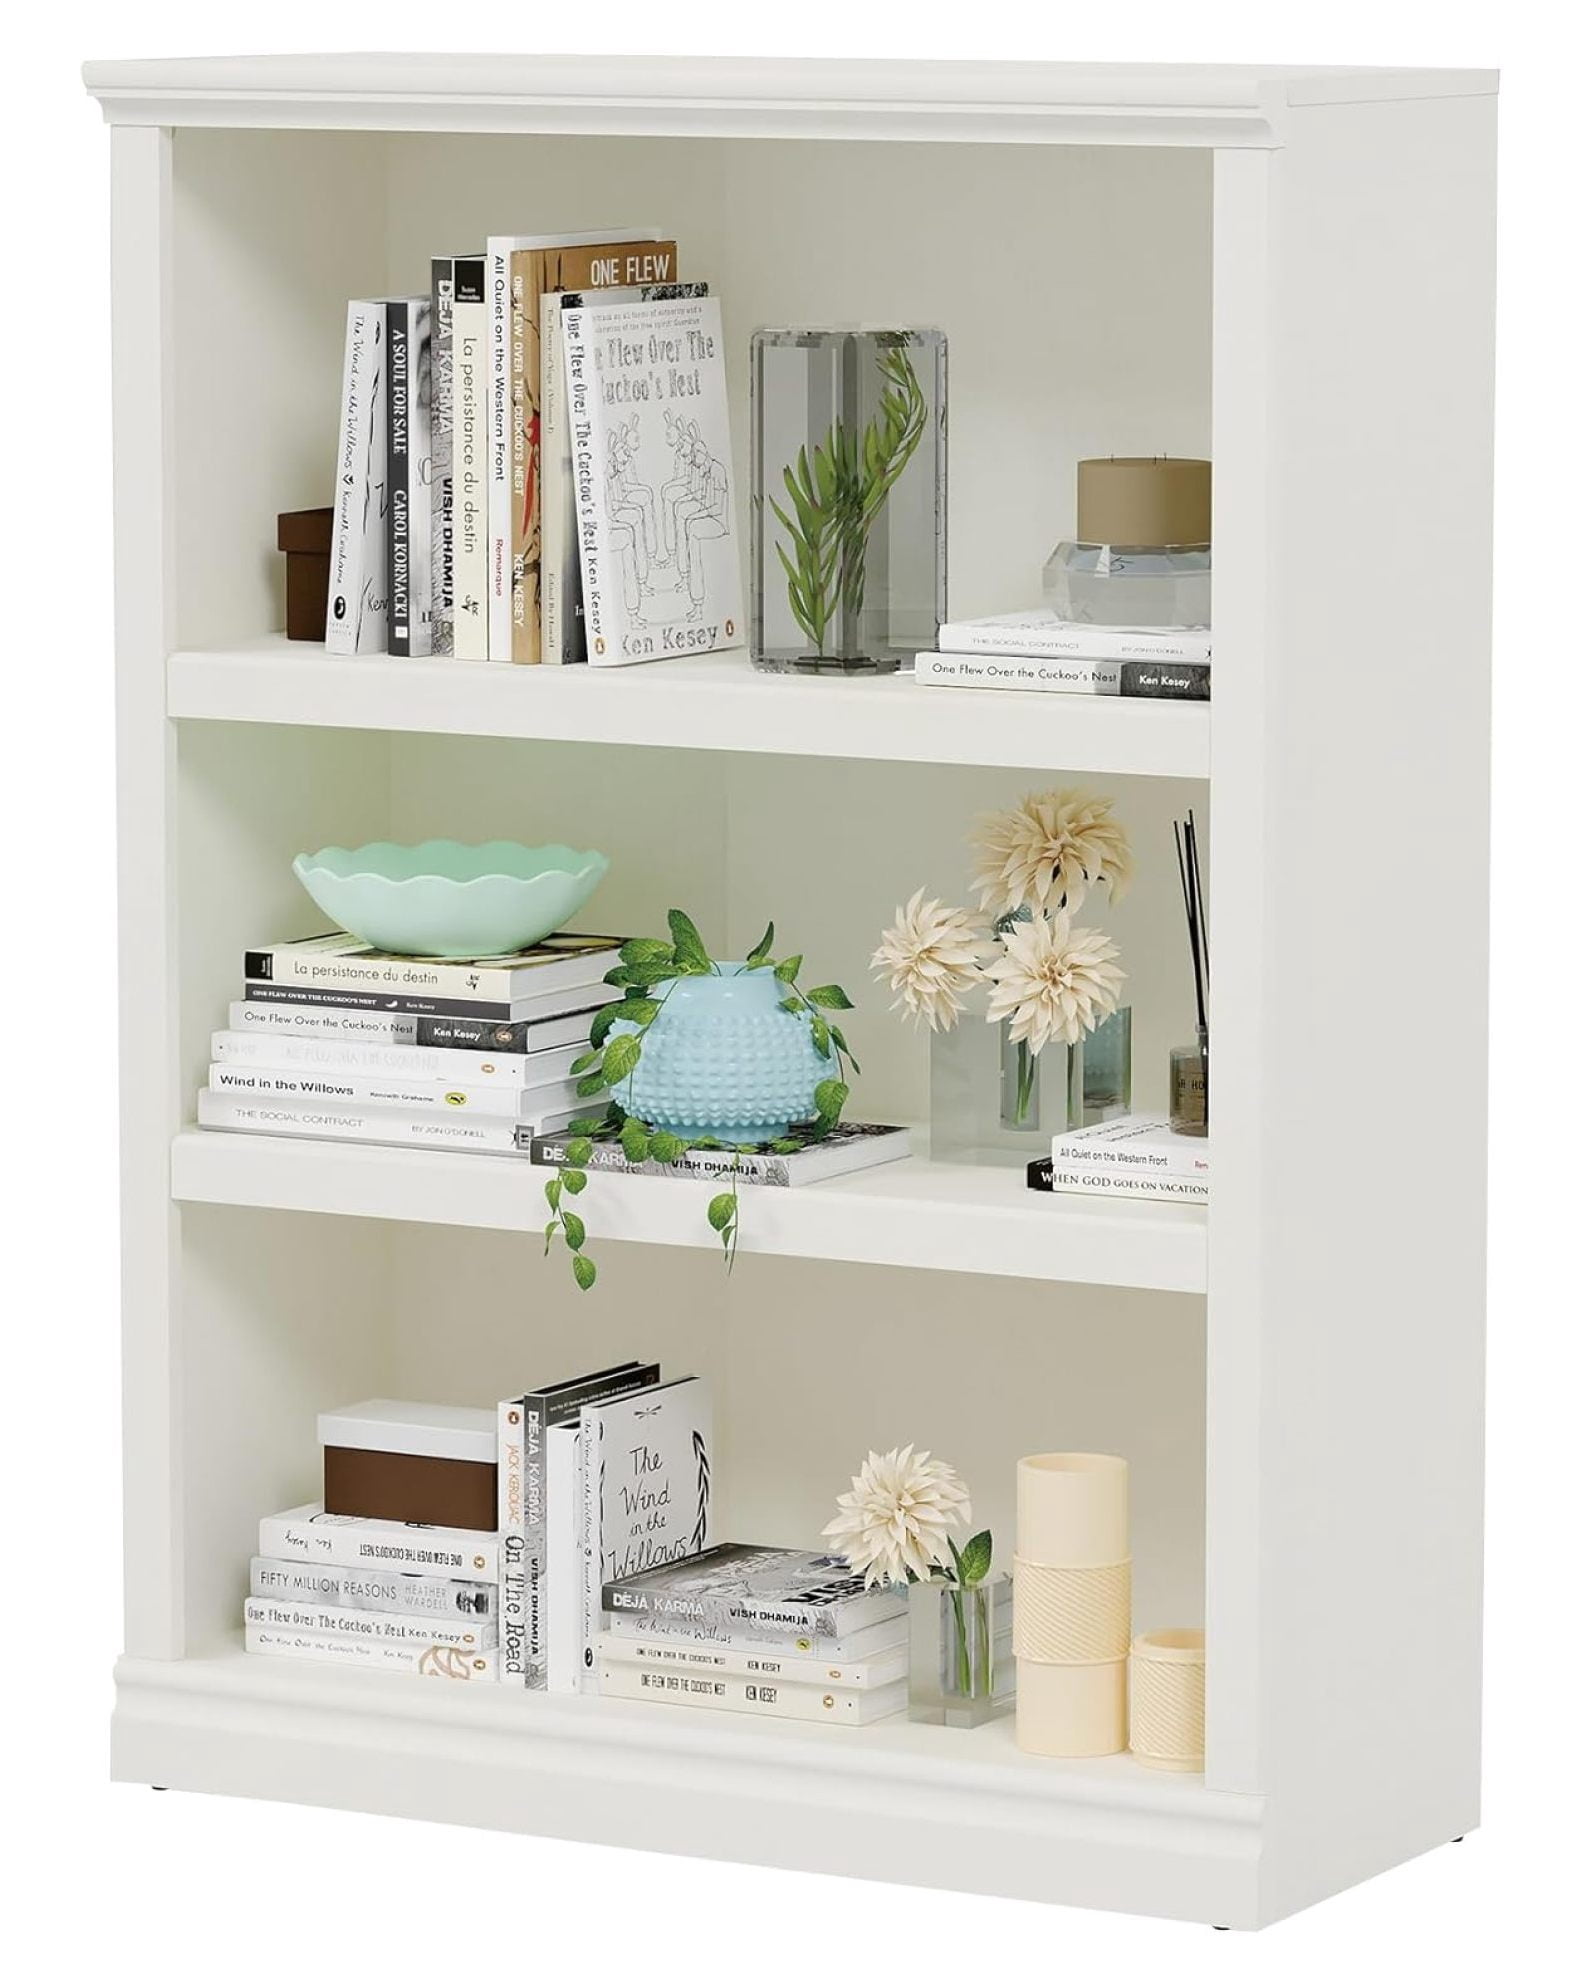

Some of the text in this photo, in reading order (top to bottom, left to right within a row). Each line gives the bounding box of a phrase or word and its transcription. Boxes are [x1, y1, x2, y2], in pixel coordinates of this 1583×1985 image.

[591, 254, 670, 286] ONE FLEW
[513, 275, 524, 298] ONE
[513, 303, 524, 338] FLEW
[567, 313, 583, 341] One
[513, 341, 524, 373] OVER
[569, 343, 586, 379] Flew
[607, 337, 644, 369] Flew
[648, 333, 682, 364] Over
[685, 329, 714, 361] The
[494, 255, 506, 481] All Quiet on the Western Front
[668, 368, 701, 398] Nest
[343, 314, 365, 469] The Wind in the Willows
[392, 329, 407, 456] A SOUL FOR SALE
[513, 378, 524, 401] THE
[572, 382, 589, 416] Over
[460, 337, 480, 554] La persistance du destin
[575, 420, 592, 448] The
[514, 465, 525, 497] NEST
[578, 451, 596, 517] Cuckoo's
[442, 477, 453, 608] VISH DHAMIJA
[582, 520, 599, 553] Nest
[393, 489, 408, 619] CAROL KORNACKI
[495, 538, 504, 597] Remarque
[588, 557, 598, 585] Ken
[513, 553, 525, 628] KEN KESEY
[590, 590, 602, 635] Kesey
[661, 625, 719, 650] Kesey
[932, 662, 1117, 682] One Flew Over the Cuckoo's Nest
[1139, 674, 1191, 689] Ken Kesey
[294, 960, 439, 985] La persistance du destin
[287, 991, 307, 1000] OVER
[244, 1010, 413, 1035] One Flew Over the Cuckoo's Nest
[433, 1026, 481, 1042] Ken Kesey
[219, 1074, 354, 1097] Wind in the Willows
[369, 1091, 436, 1103] Kenneth Grahame
[235, 1108, 365, 1128] THE SOCIAL CONTRACT
[671, 1159, 759, 1176] VISH DHAMIJA
[1059, 1147, 1168, 1167] All Quiet on the Western Front
[1040, 1170, 1209, 1195] WHEN GOD GOES ON VACATION
[505, 1443, 520, 1525] JACK KEROUAC
[528, 1462, 541, 1526] KARMA
[618, 1445, 671, 1517] The Wind
[629, 1511, 667, 1537] in the
[359, 1543, 463, 1567] ONE FLEW OVER THE CUCKOO'S NEST
[607, 1535, 688, 1580] Willows
[260, 1571, 398, 1600] FIFTY MILLION REASONS
[404, 1584, 447, 1598] HEATHER
[404, 1597, 449, 1611] WARDELL
[504, 1534, 526, 1675] On The Road
[530, 1557, 539, 1656] VISH DHAMIJA
[654, 1597, 705, 1616] KARMA
[729, 1607, 809, 1626] VISH DHAMIJA
[247, 1605, 265, 1621] One
[268, 1608, 291, 1624] Flew
[293, 1611, 316, 1627] Over
[318, 1614, 336, 1630] The
[408, 1627, 428, 1638] Ken
[430, 1630, 462, 1644] Kesey
